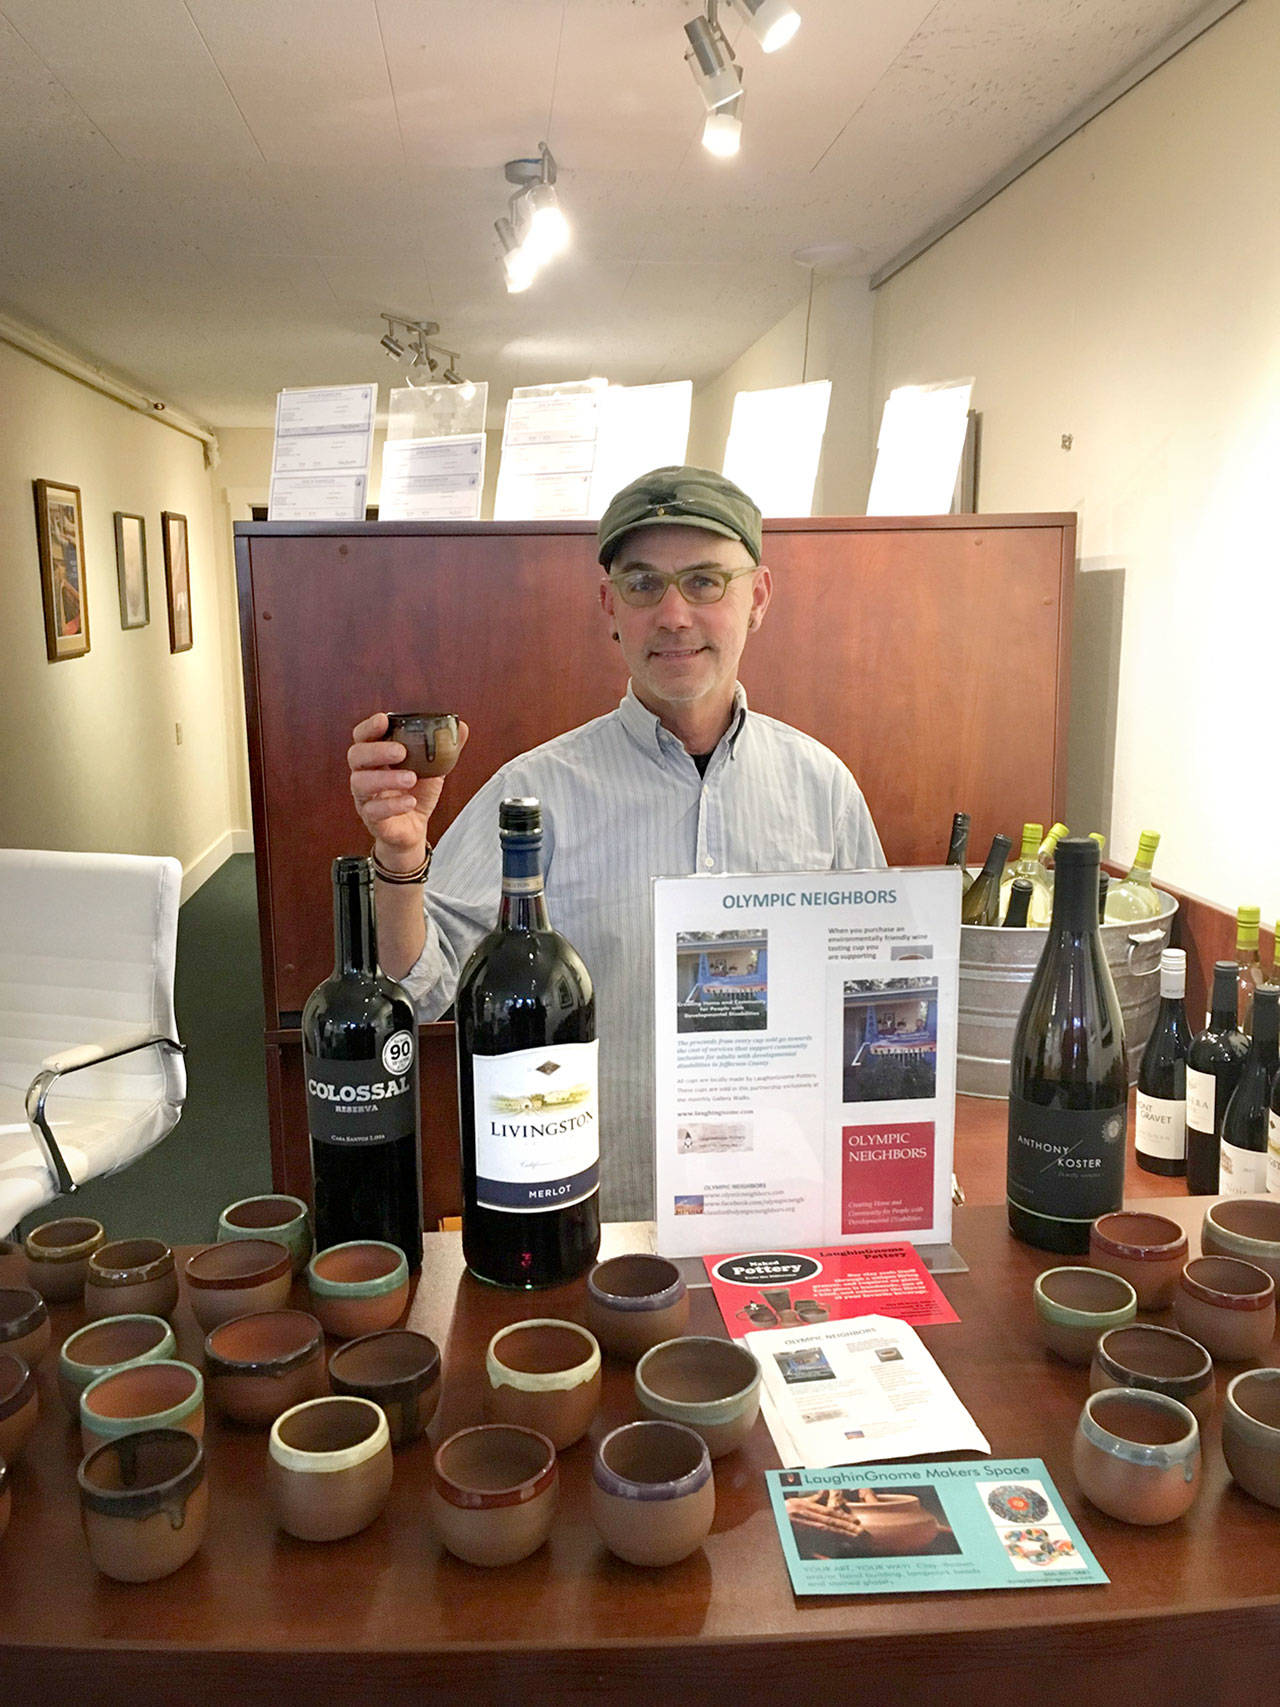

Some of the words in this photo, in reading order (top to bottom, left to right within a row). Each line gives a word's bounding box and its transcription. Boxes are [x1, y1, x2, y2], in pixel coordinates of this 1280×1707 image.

[722, 892, 797, 909] OLYMPIC
[801, 889, 897, 907] NEIGHBORS
[850, 927, 862, 935] you
[864, 926, 895, 935] purchase
[828, 935, 882, 943] environmentally
[389, 1040, 411, 1061] 90
[308, 1077, 410, 1102] COLOSSAL
[335, 1104, 379, 1113] RESERVA
[490, 1111, 593, 1138] LIVINGSTON
[1140, 1110, 1172, 1124] GRAVET
[848, 1132, 911, 1147] OLYMPIC
[1017, 1135, 1070, 1155] ANTHONY
[848, 1146, 928, 1163] NEIGHBORS
[1057, 1158, 1102, 1168] KOSTER
[528, 1184, 572, 1199] MERLOT
[731, 1182, 766, 1190] NEIGHBORS
[819, 1247, 904, 1257] LaughinGnome
[864, 1252, 906, 1260] Pottery
[731, 1263, 802, 1276] Pottery
[784, 1335, 822, 1346] OLYMPIC
[825, 1327, 877, 1340] NEIGHBORS
[804, 1471, 921, 1486] LaughinGnome
[925, 1466, 979, 1481] Makers
[983, 1465, 1030, 1478] Space
